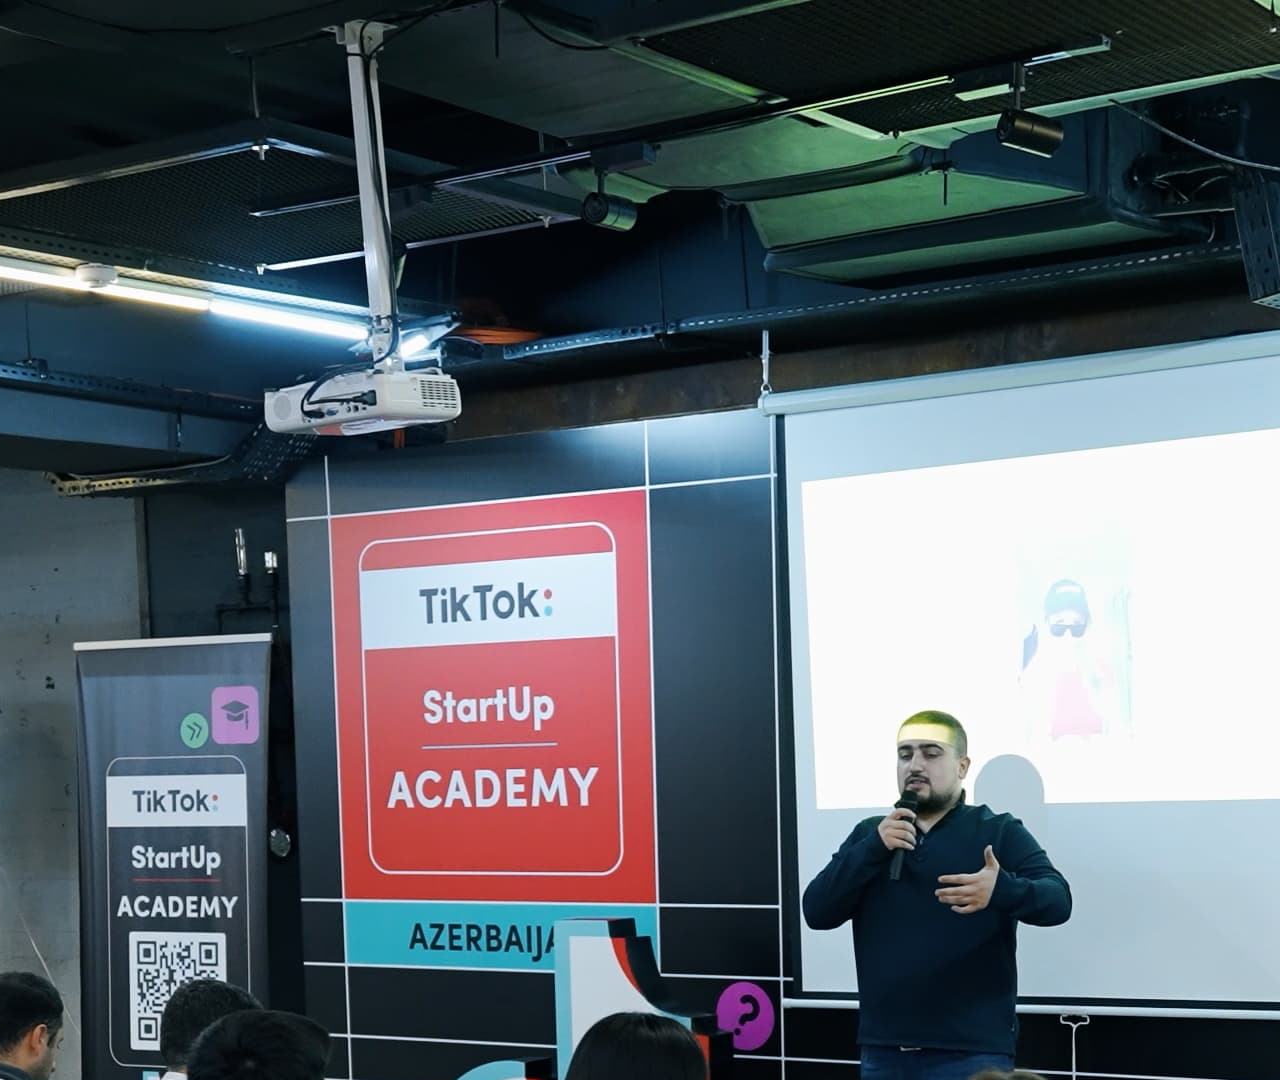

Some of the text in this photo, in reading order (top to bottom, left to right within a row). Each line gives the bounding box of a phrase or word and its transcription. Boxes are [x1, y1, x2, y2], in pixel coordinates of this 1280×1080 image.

[422, 685, 555, 731] StartUp
[387, 767, 599, 809] ACADEMY
[131, 844, 222, 876] StartUp
[116, 895, 239, 919] ACADEMY
